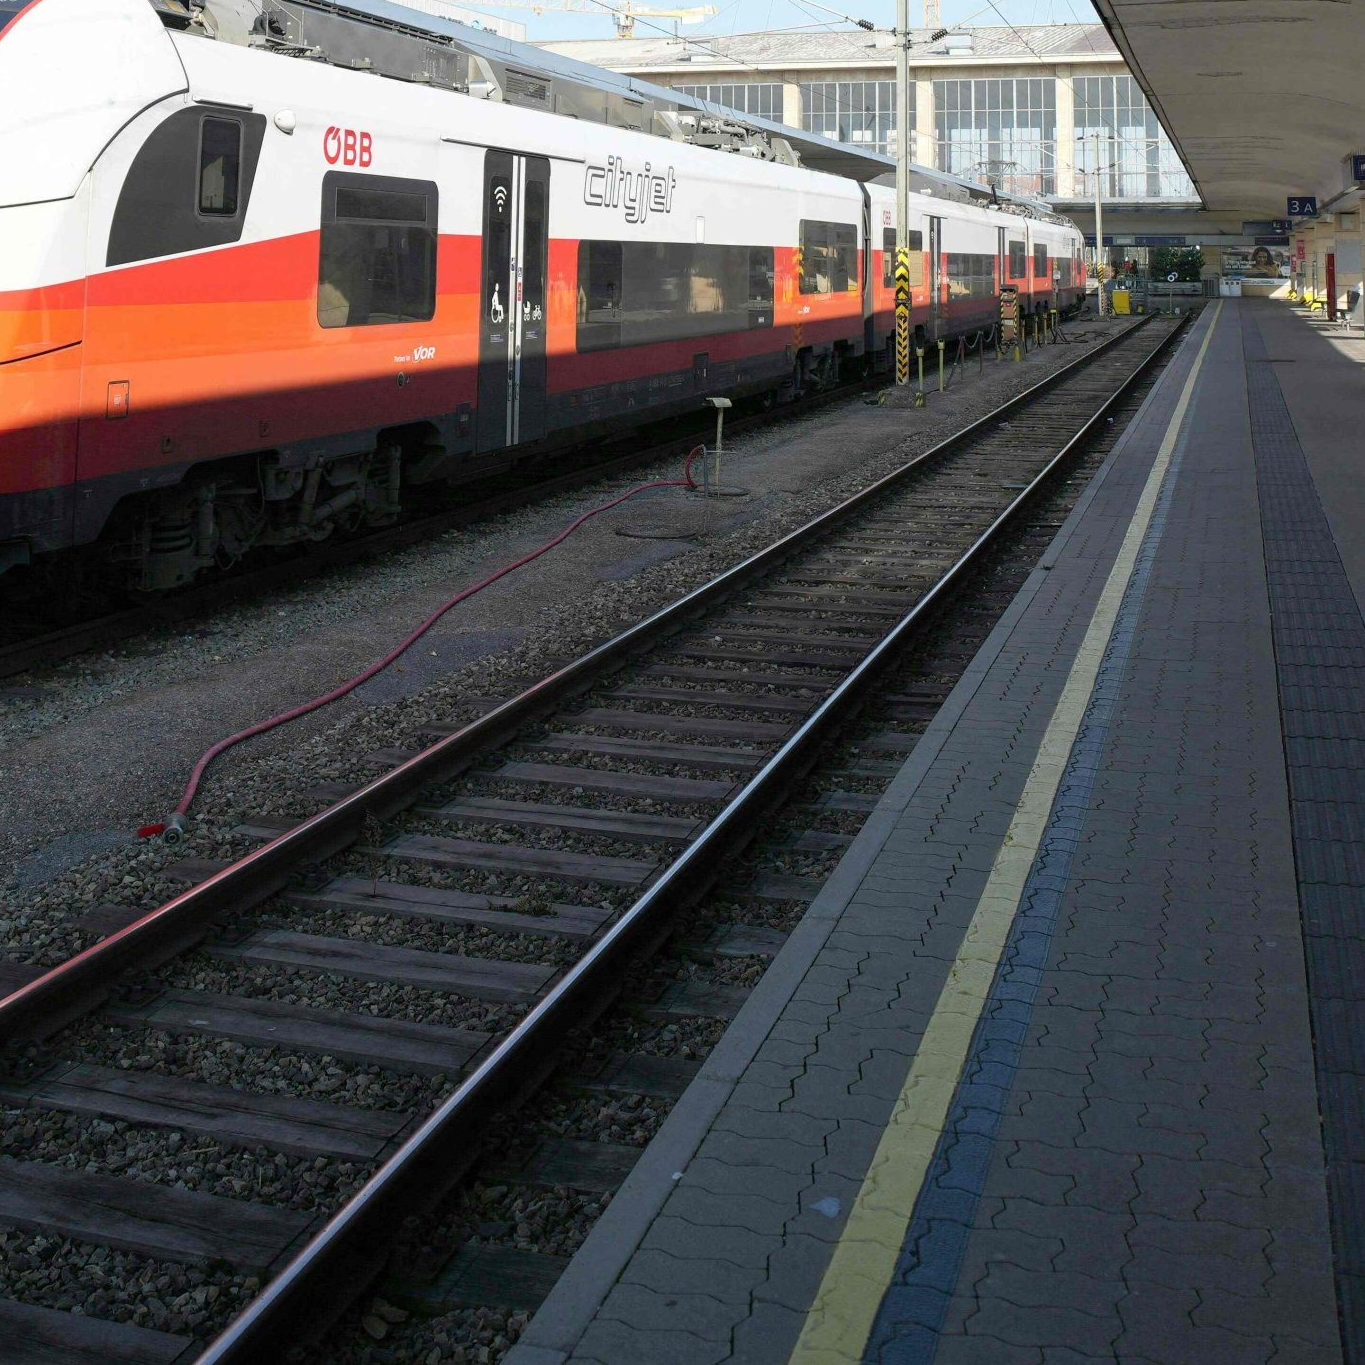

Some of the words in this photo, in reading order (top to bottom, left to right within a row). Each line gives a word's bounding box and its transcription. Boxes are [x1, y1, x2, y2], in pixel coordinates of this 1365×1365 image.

[323, 126, 373, 167] ÖBB
[584, 155, 676, 224] cityjet
[1290, 200, 1300, 213] 3
[1304, 203, 1314, 213] A
[412, 345, 436, 363] VOR
